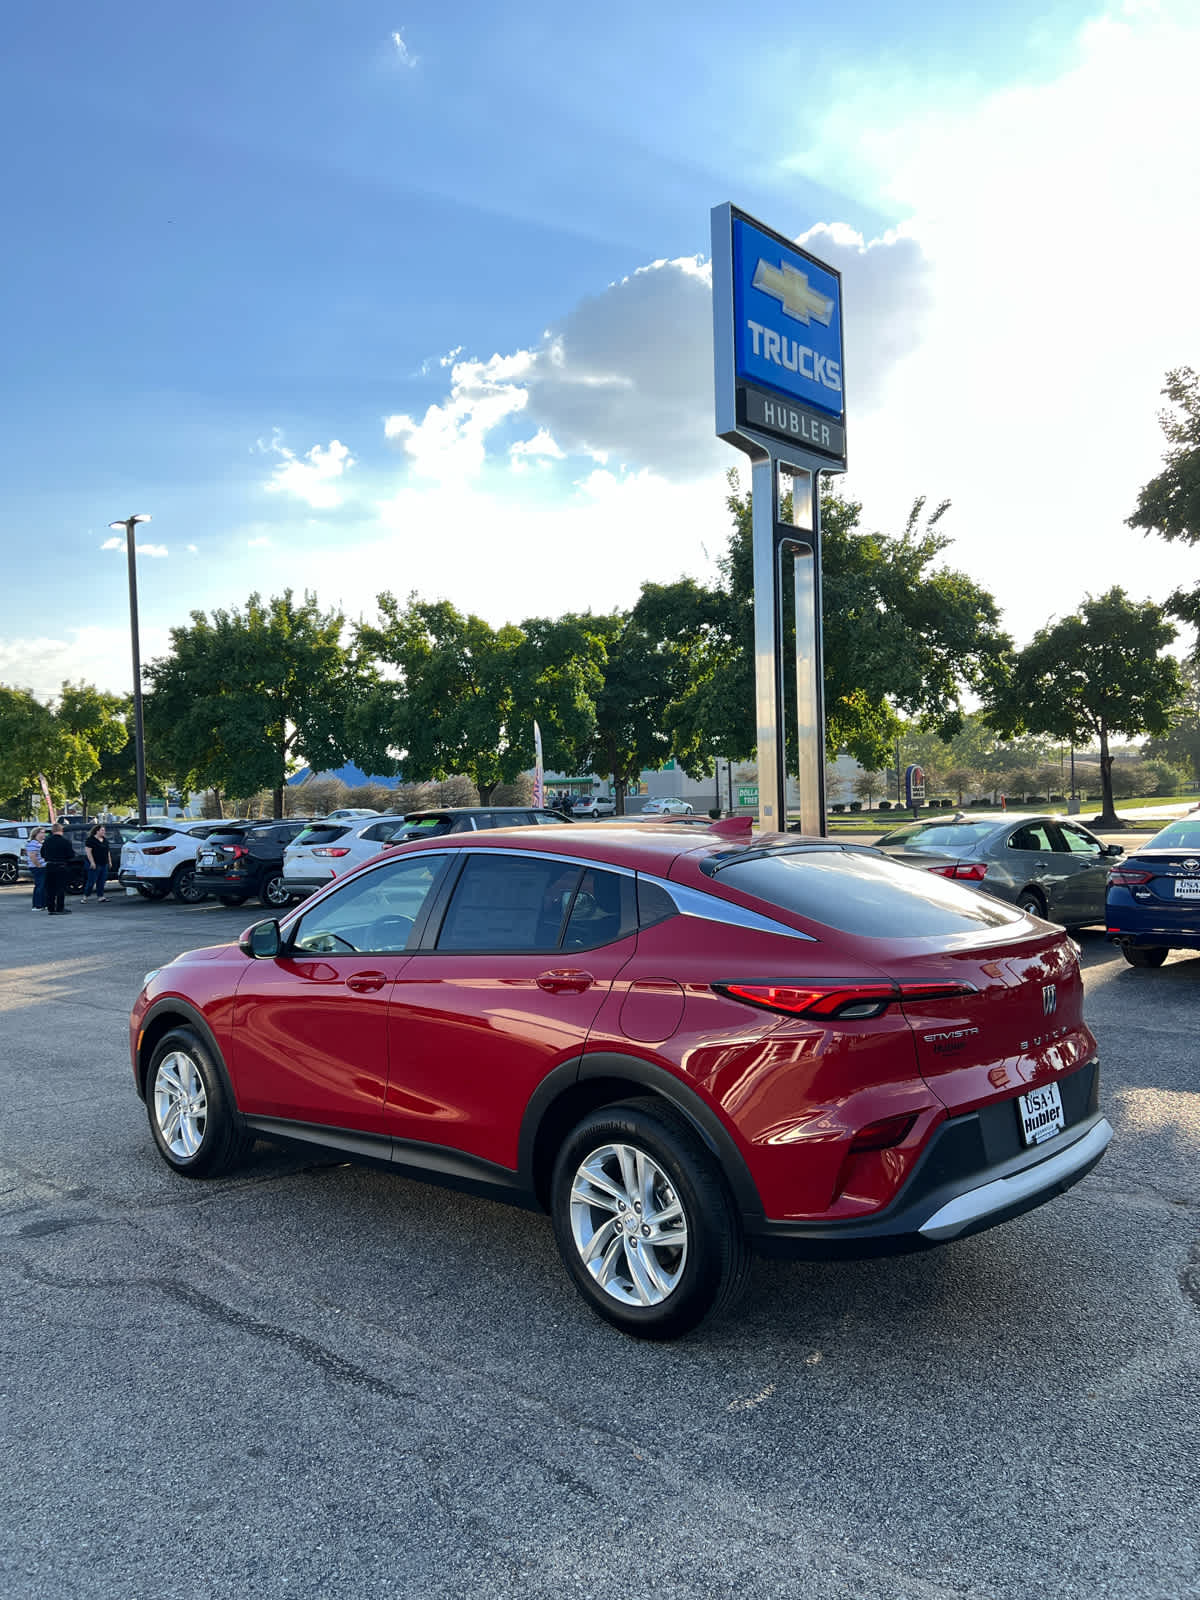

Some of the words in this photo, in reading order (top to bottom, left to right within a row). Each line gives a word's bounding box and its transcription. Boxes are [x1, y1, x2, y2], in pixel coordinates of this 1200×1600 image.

[747, 319, 842, 391] TRUCKS
[764, 400, 830, 446] HUBLER
[739, 789, 758, 797] DOLLA
[923, 1027, 979, 1042] ENVISTA
[1020, 1026, 1067, 1049] BUICK
[1025, 1106, 1060, 1133] Hubler
